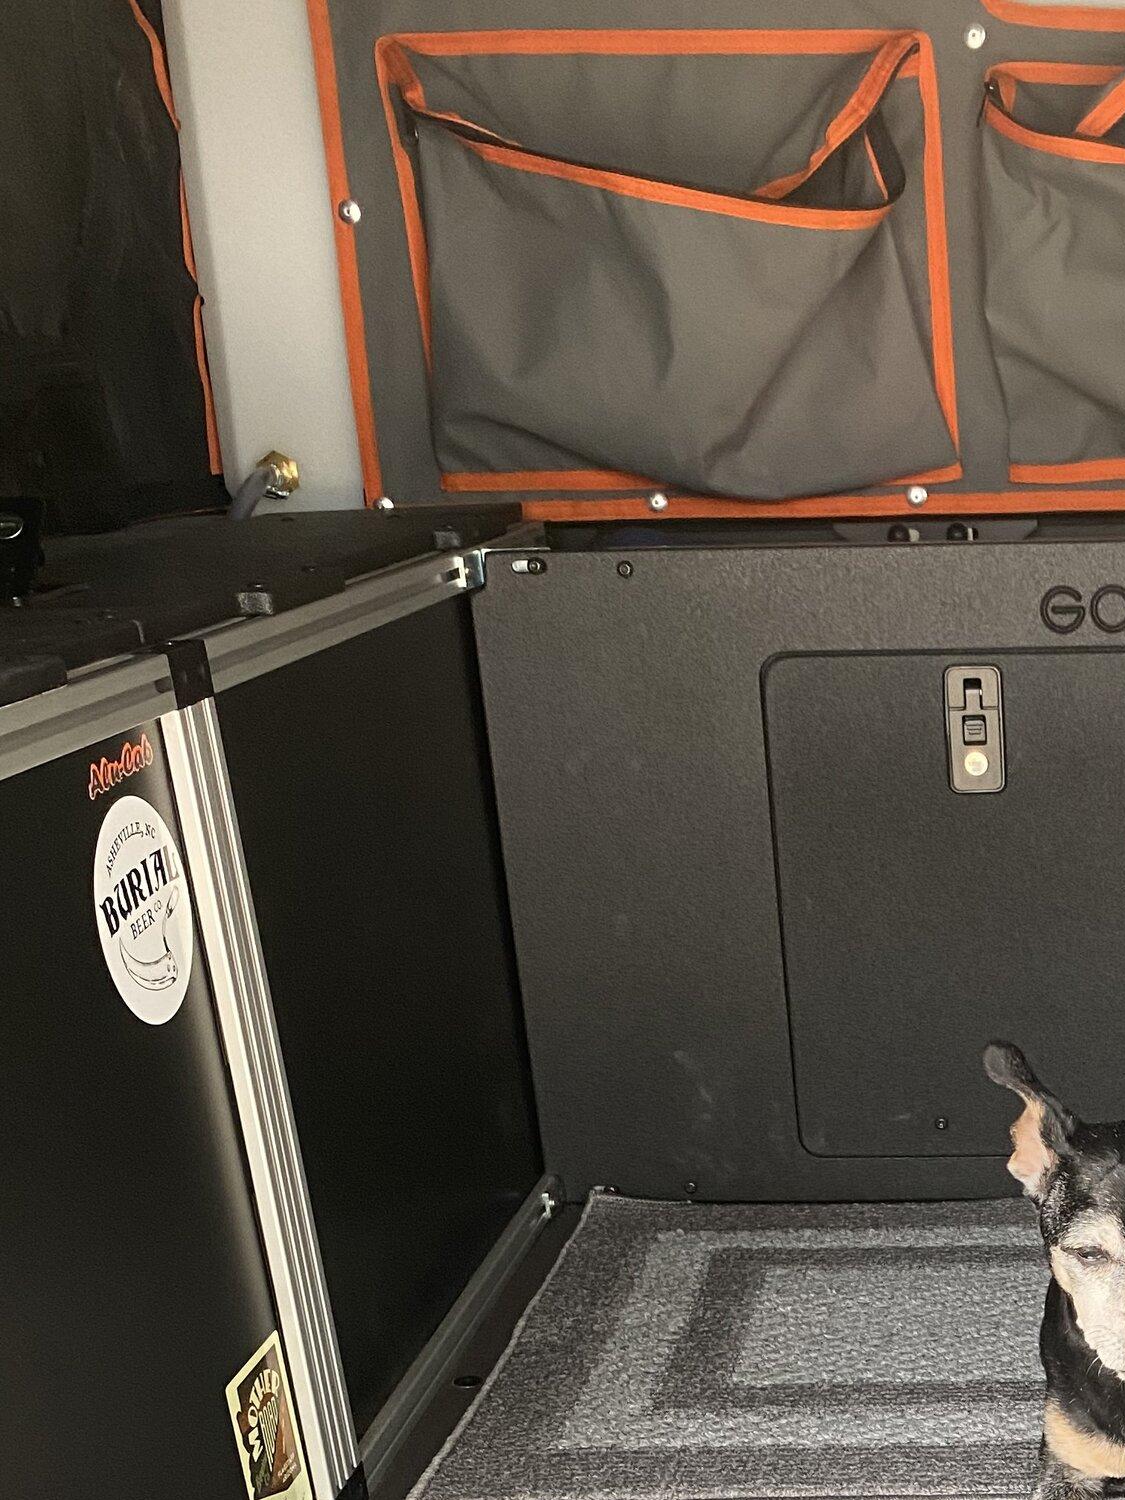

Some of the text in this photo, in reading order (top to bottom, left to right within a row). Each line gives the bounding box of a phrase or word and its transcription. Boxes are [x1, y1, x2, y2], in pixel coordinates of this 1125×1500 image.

[99, 845, 180, 938] BURIAL
[130, 908, 156, 940] BEER
[248, 1368, 280, 1463] MOTHER
[259, 1396, 279, 1472] ROAD
